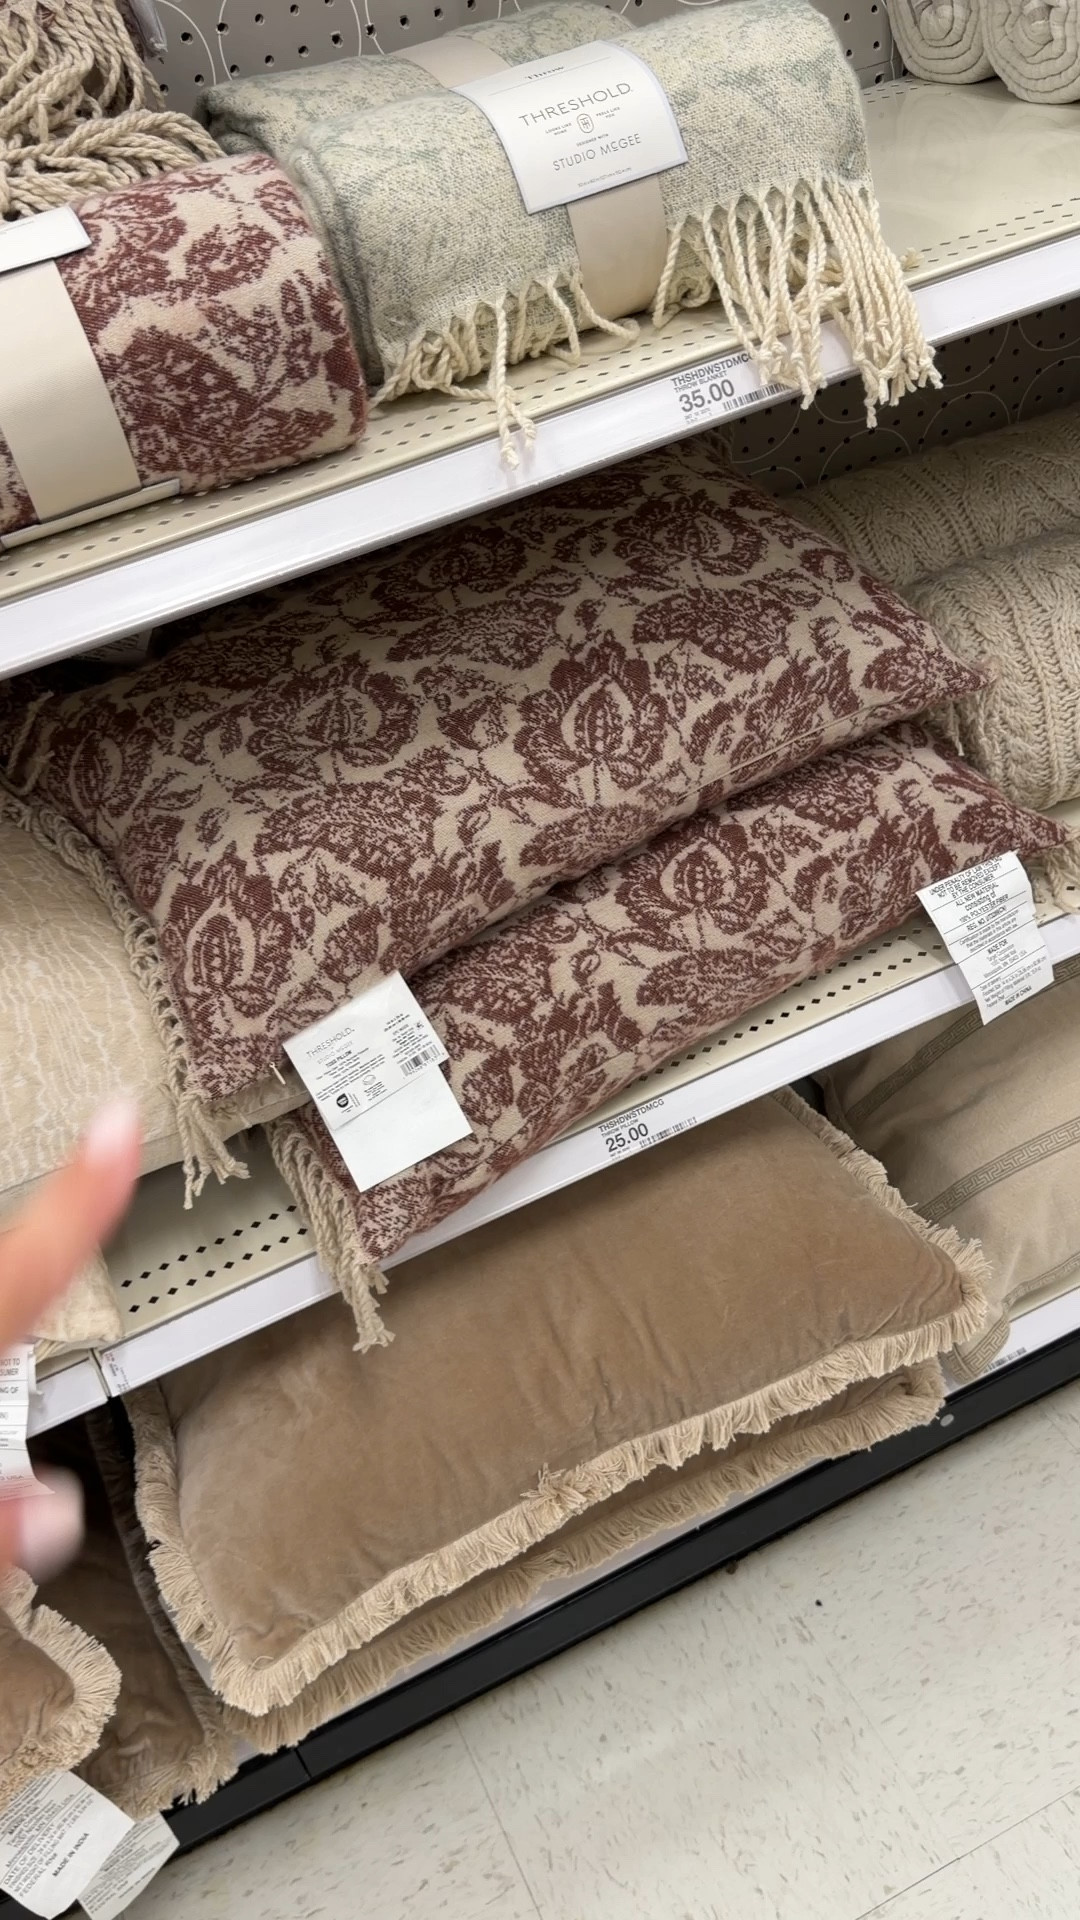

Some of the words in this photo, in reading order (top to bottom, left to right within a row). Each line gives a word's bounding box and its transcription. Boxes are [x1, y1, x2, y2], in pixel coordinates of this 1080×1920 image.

[519, 82, 631, 127] THRESHOLD
[552, 149, 596, 171] STUDIO
[679, 379, 735, 413] 35.00
[598, 1099, 665, 1133] THSHDWSTDMCG
[606, 1123, 648, 1152] 25.00
[52, 1858, 69, 1877] MADE
[73, 1831, 89, 1850] INDIA
